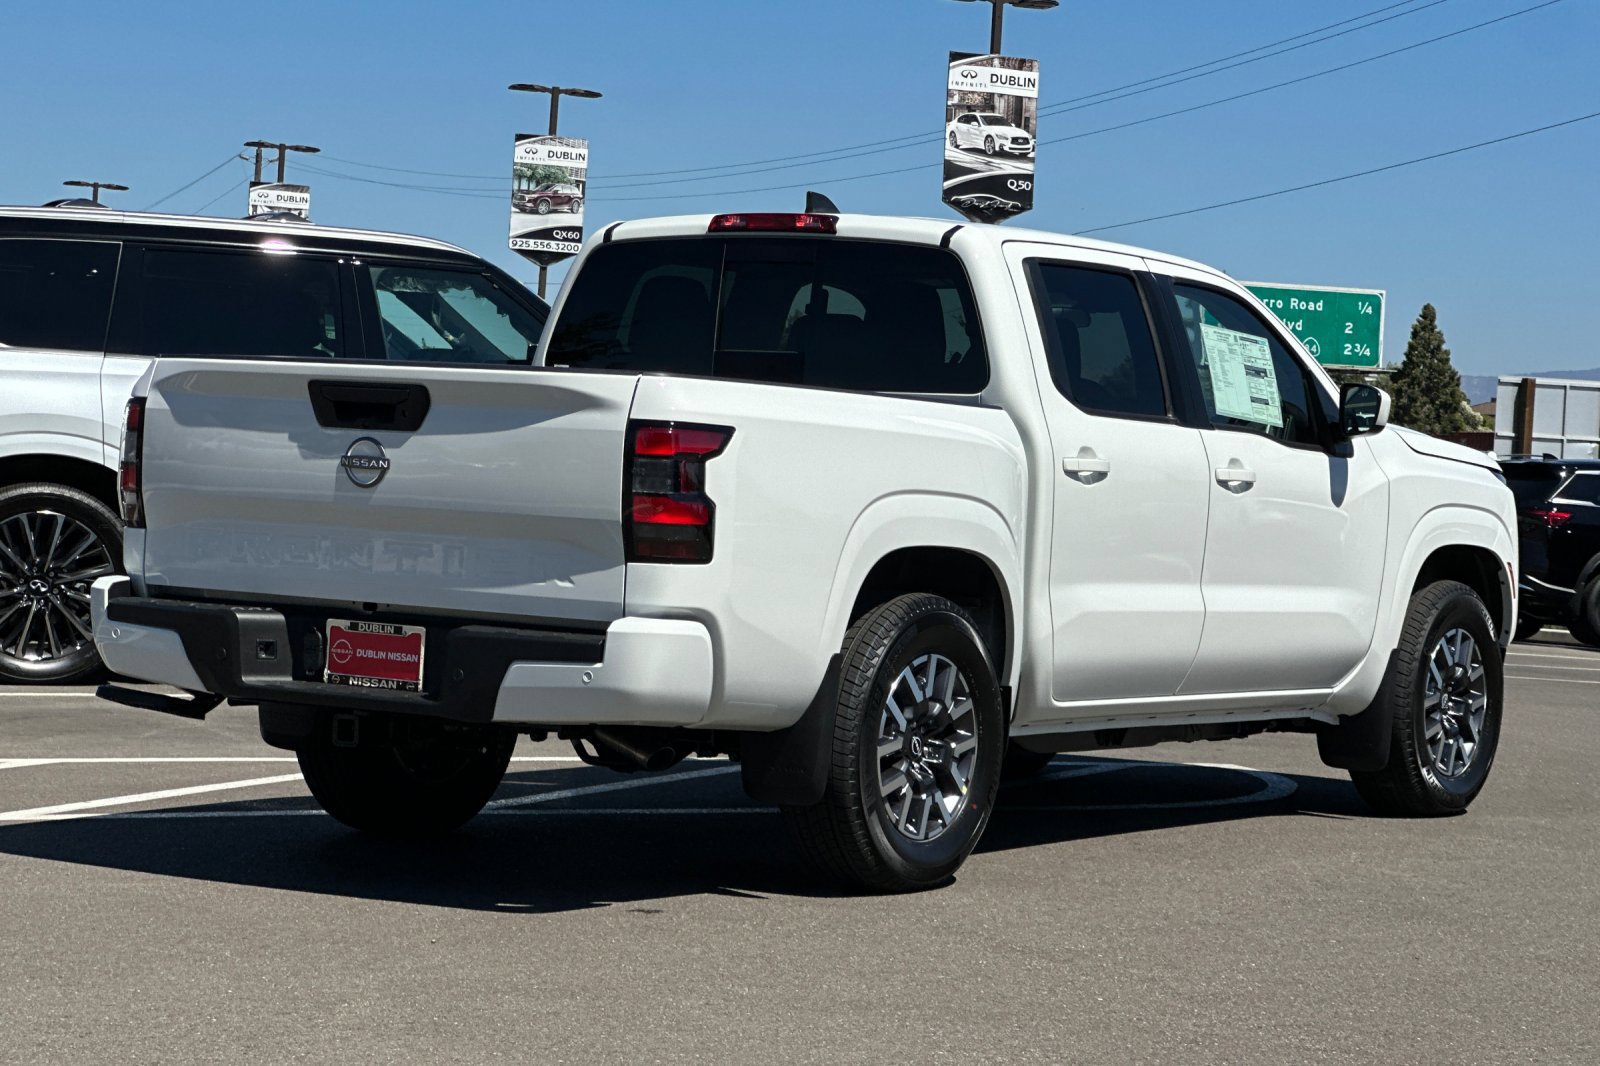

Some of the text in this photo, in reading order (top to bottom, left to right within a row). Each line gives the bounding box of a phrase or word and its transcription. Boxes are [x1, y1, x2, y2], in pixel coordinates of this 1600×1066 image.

[951, 73, 1036, 88] INFINITI DUBLIN
[547, 150, 586, 161] DUBLIN
[1007, 179, 1032, 192] Q50
[276, 194, 308, 204] DUBLIN
[553, 230, 580, 240] QX60
[511, 239, 580, 252] 925.556.3200
[1290, 297, 1324, 311] Road
[1344, 322, 1354, 334] 2
[341, 457, 388, 468] NISSAN
[358, 623, 395, 634] DUBLIN
[331, 647, 353, 655] NISSAN
[356, 648, 419, 663] DUBLIN NISSAN
[349, 676, 397, 689] NISSAN
